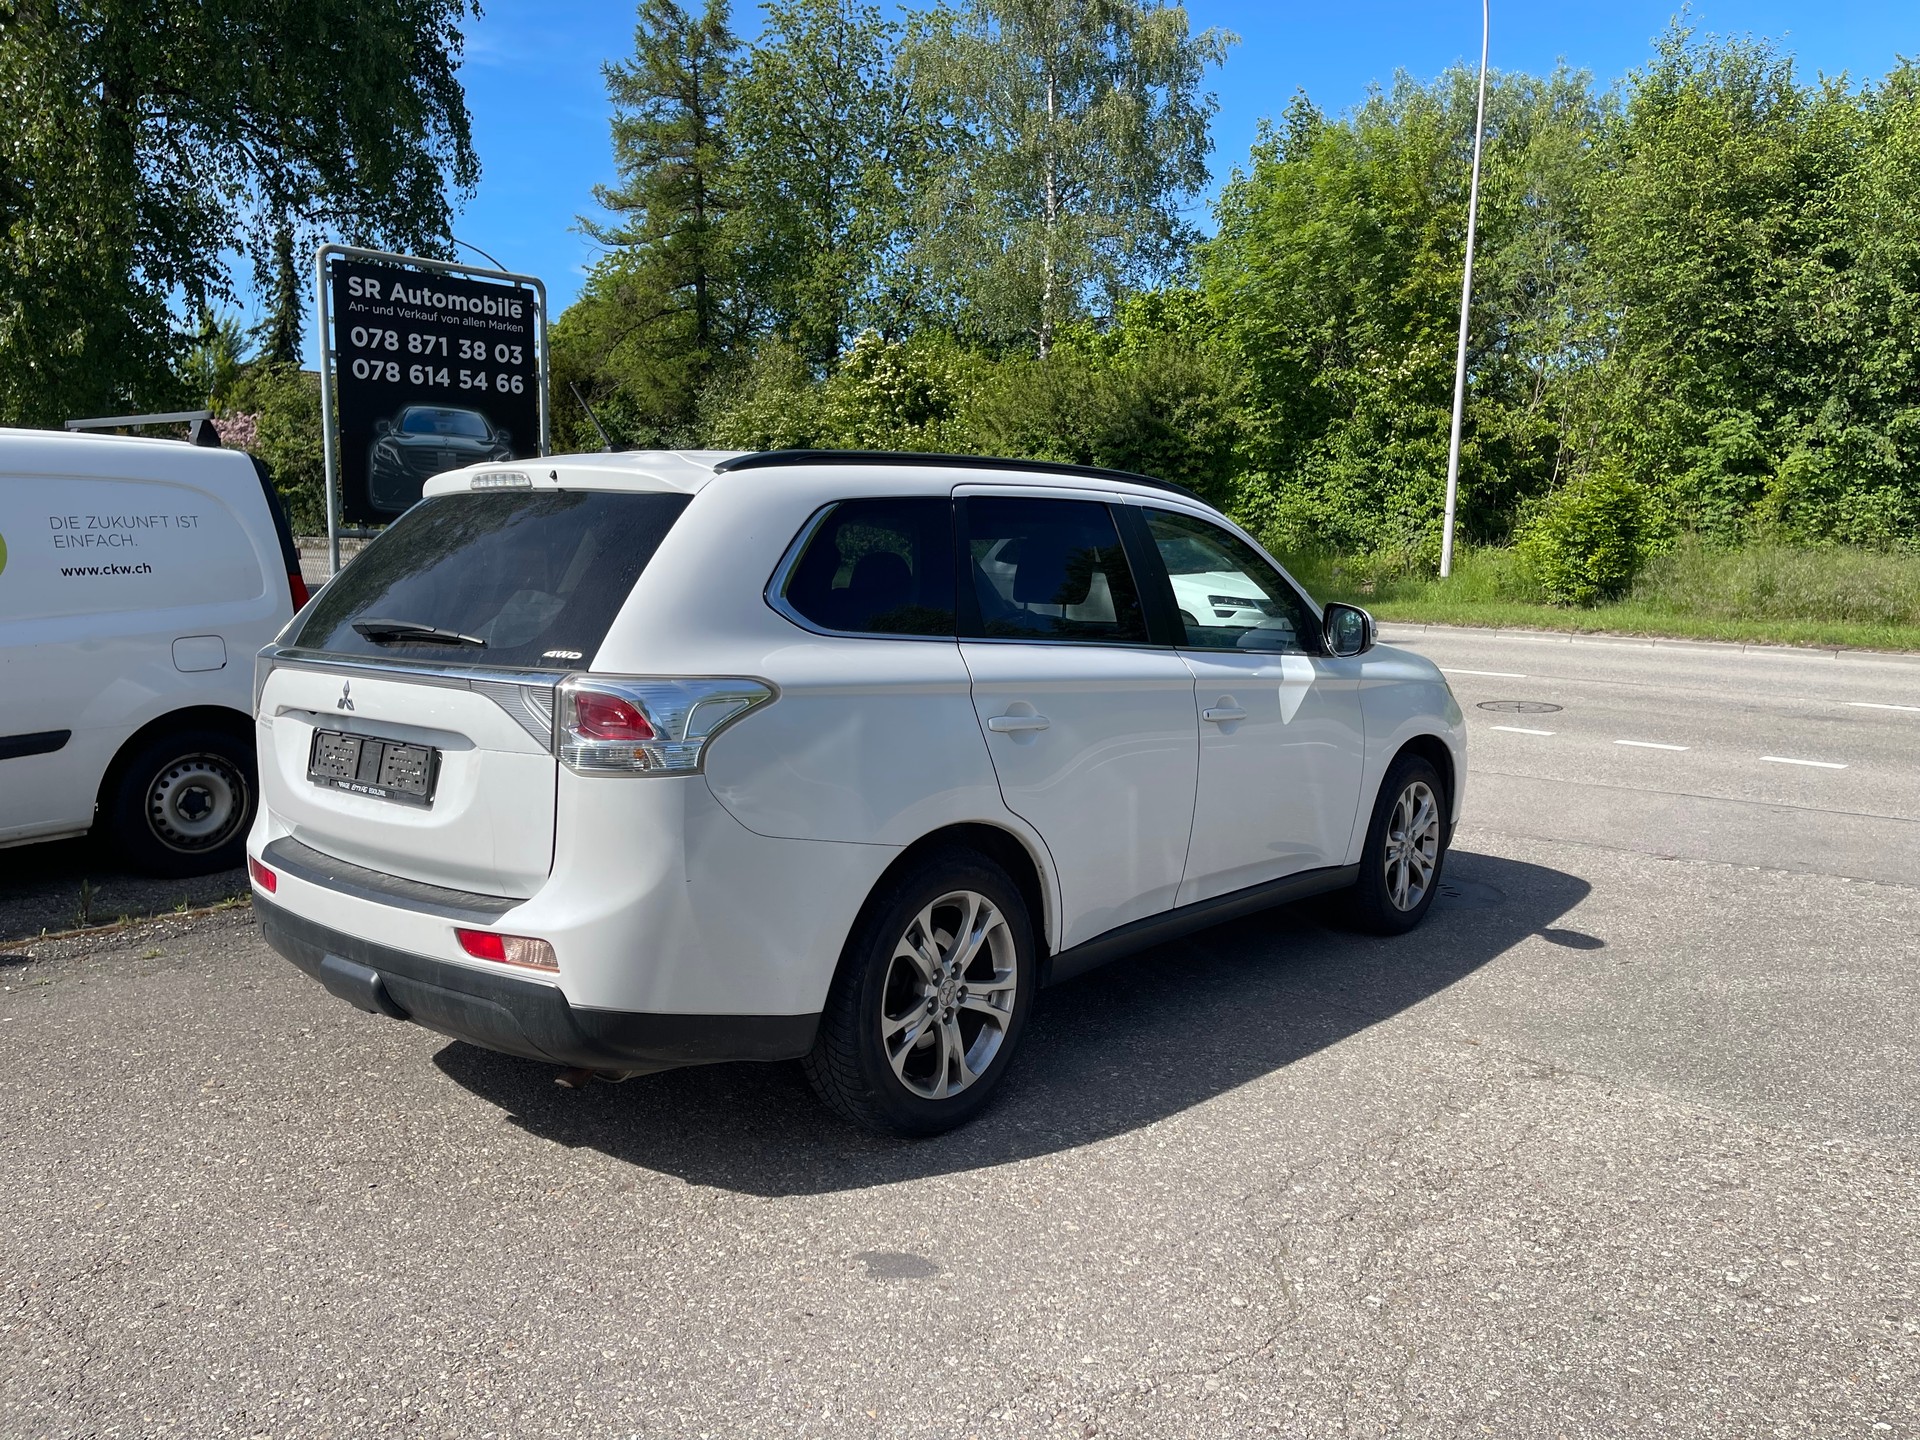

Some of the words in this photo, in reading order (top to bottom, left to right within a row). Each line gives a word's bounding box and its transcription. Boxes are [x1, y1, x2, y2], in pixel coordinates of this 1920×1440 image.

[348, 276, 381, 300] SR
[390, 283, 523, 319] Automobile
[348, 301, 369, 313] An-
[372, 305, 394, 316] und
[397, 307, 438, 322] Verkauf
[441, 315, 460, 325] von
[463, 317, 486, 328] allen
[488, 320, 524, 333] Marken
[350, 326, 399, 351] 078
[407, 333, 448, 357] 871
[458, 339, 487, 361] 38
[494, 344, 523, 365] 03
[352, 358, 401, 383] 078
[409, 364, 450, 387] 614
[459, 369, 488, 391] 54
[496, 373, 524, 395] 66
[49, 515, 81, 530] DIE
[86, 515, 169, 529] ZUKUNFT
[175, 515, 199, 529] IST
[53, 533, 138, 549] EINFACH.
[60, 562, 152, 577] www.ckw.ch
[542, 650, 583, 660] 4WD
